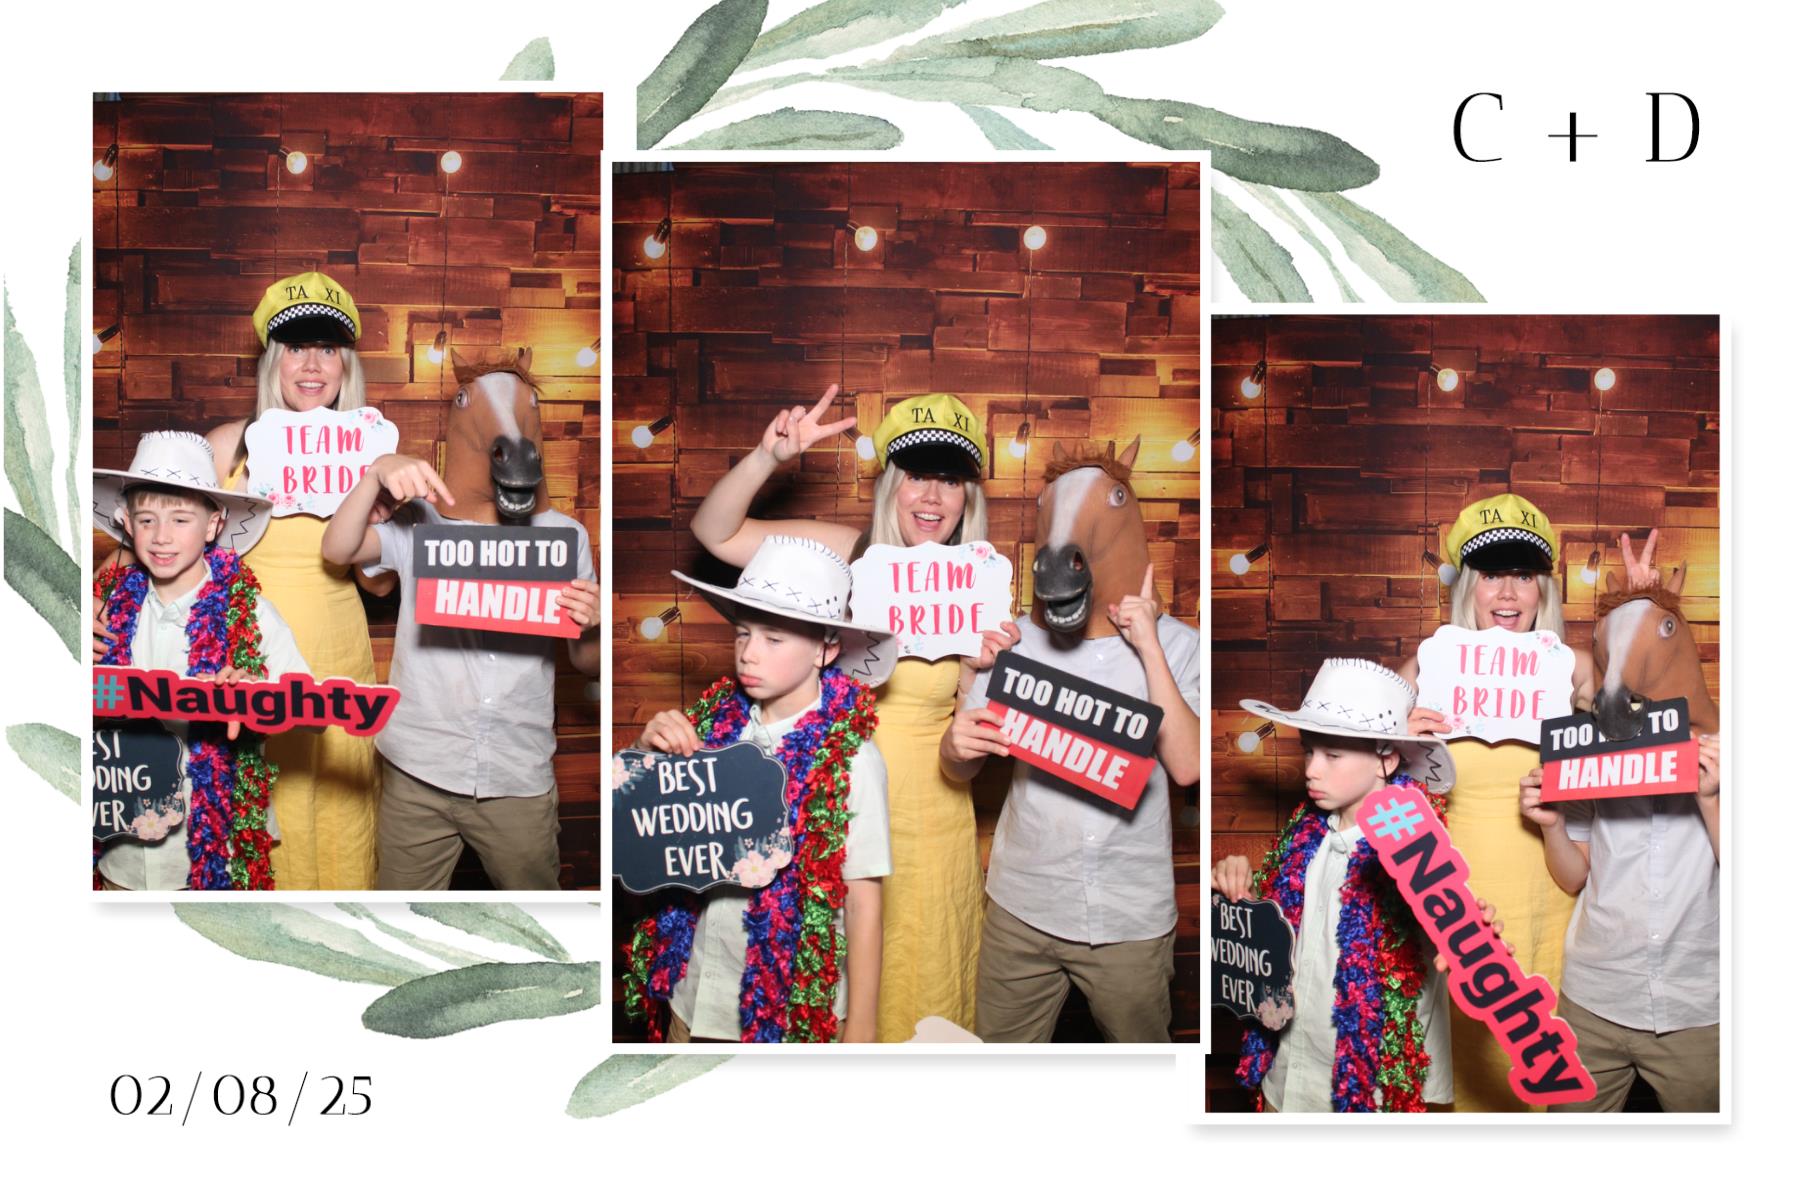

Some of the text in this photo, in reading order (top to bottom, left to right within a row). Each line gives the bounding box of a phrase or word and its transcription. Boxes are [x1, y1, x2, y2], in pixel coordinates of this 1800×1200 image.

[282, 425, 365, 455] TEAM
[424, 539, 568, 567] TOO HOT TO
[888, 560, 977, 593] TEAM
[434, 579, 562, 624] HANDLE
[888, 602, 985, 635] BRIDE
[1456, 644, 1541, 677] TEAM
[93, 674, 389, 730] #Naughty
[1003, 667, 1149, 740] TOO HOT TO
[1452, 685, 1547, 721] BRIDE
[1000, 707, 1130, 791] HANDLE
[1550, 723, 1593, 751] TOO
[1648, 708, 1679, 734] TO
[658, 757, 718, 796] BEST
[1558, 750, 1678, 791] HANDLE
[631, 798, 754, 837] WEDDING
[664, 841, 731, 880] EVER
[1220, 902, 1253, 939] BEST
[1366, 797, 1584, 1095] #Naughty
[1221, 974, 1258, 1014] EVER
